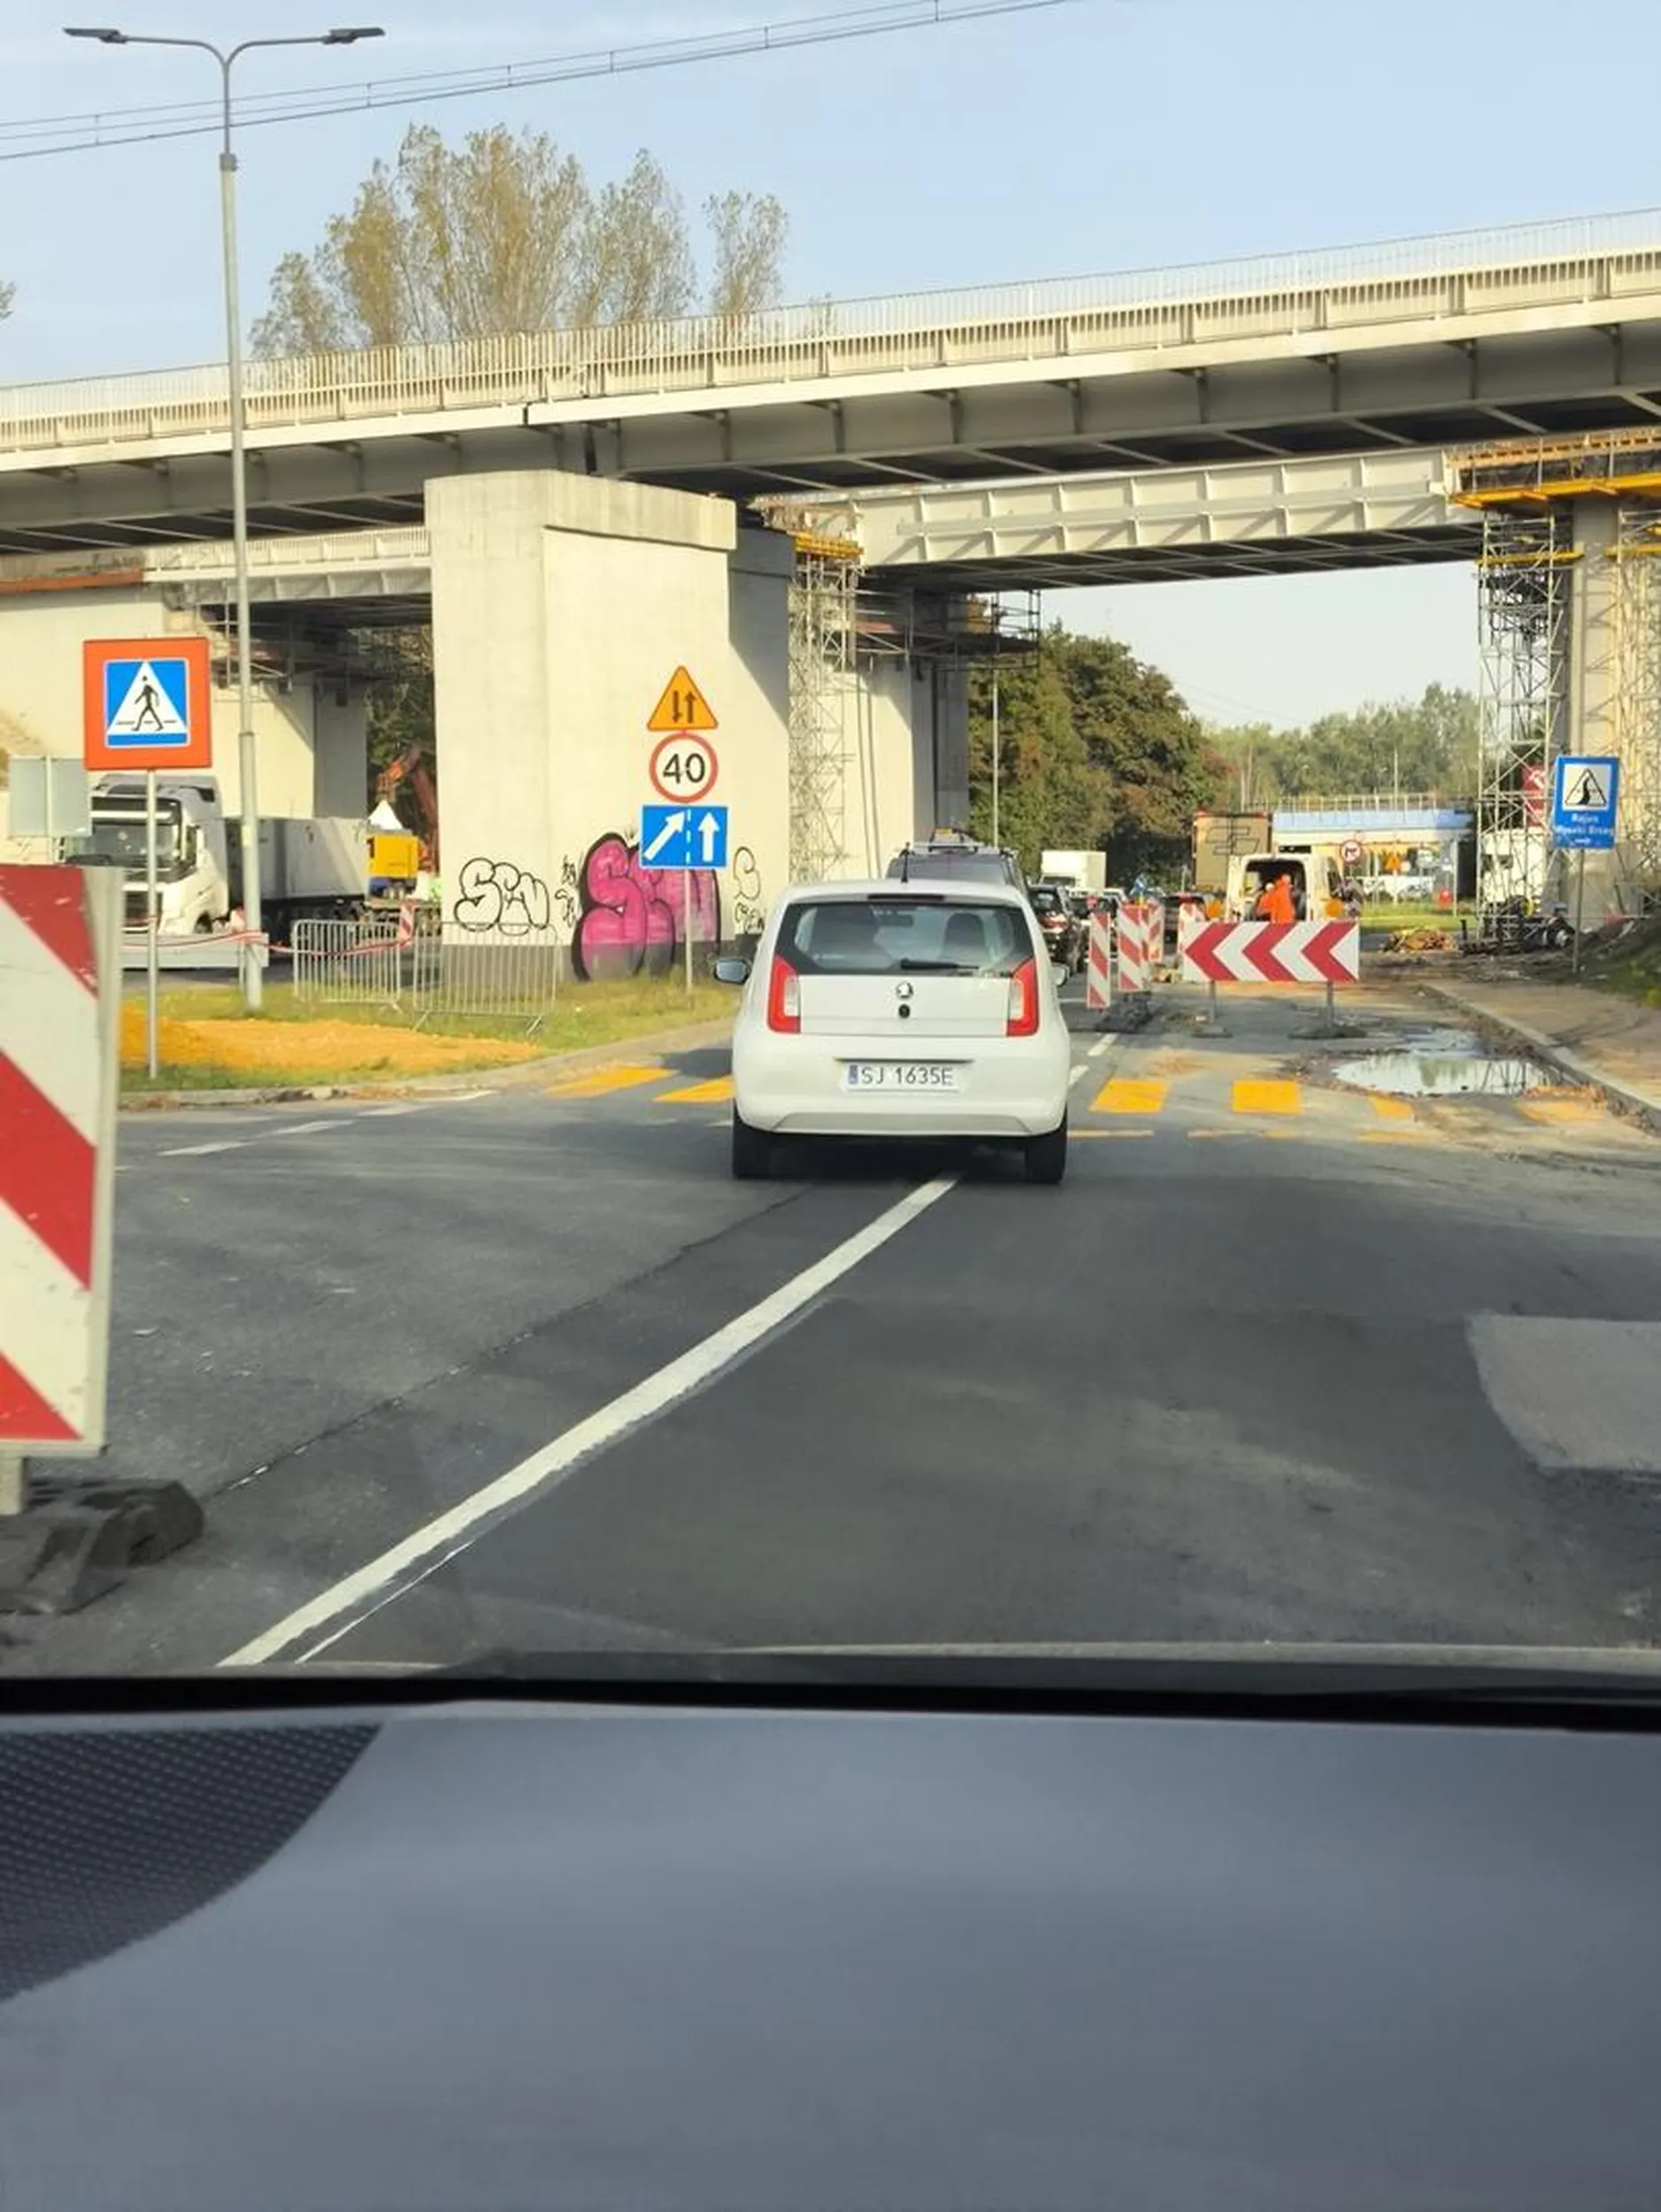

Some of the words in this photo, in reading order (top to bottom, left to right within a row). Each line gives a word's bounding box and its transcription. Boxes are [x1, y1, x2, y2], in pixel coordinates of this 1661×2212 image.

[662, 752, 705, 785] 40
[861, 1065, 885, 1084] SJ
[895, 1065, 954, 1086] 1635E
